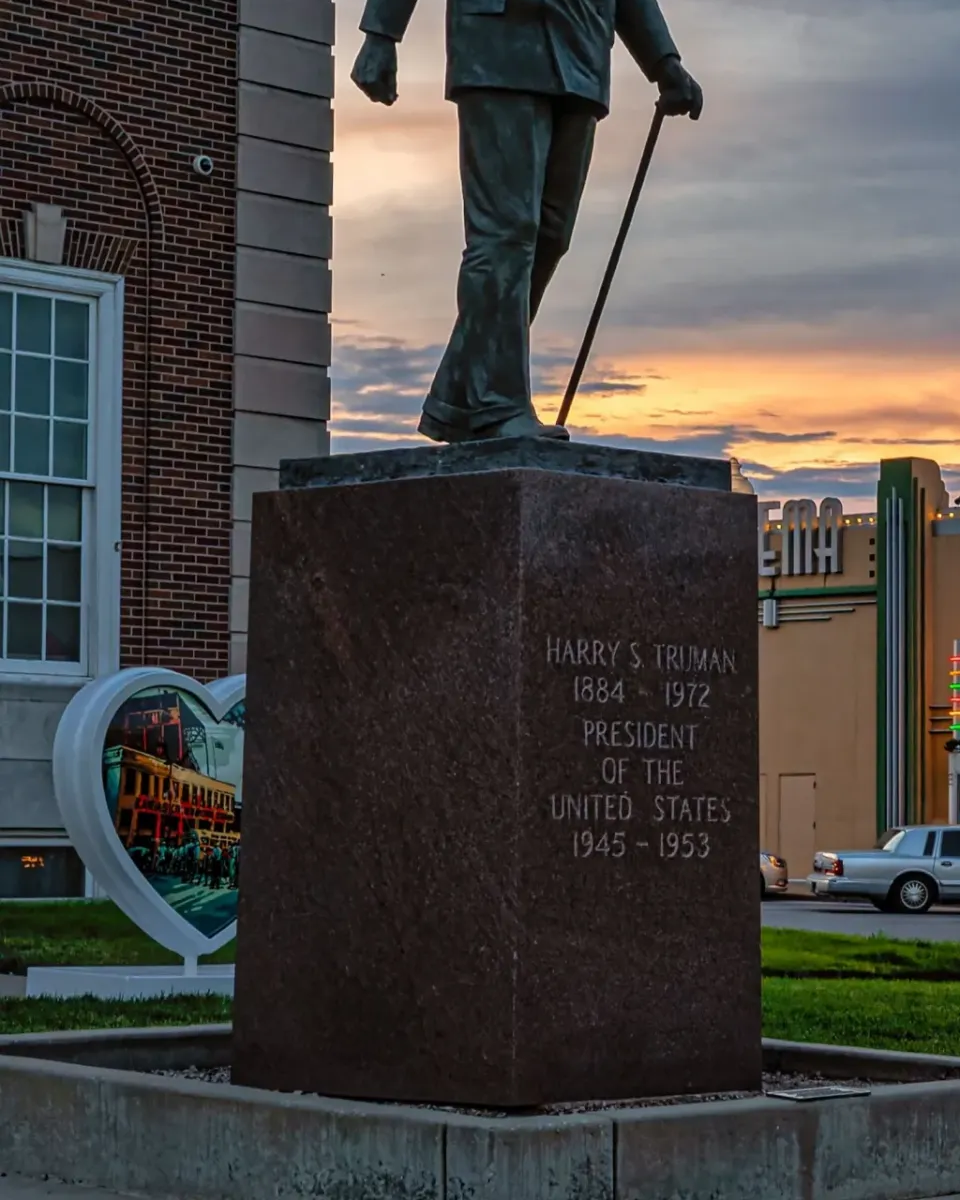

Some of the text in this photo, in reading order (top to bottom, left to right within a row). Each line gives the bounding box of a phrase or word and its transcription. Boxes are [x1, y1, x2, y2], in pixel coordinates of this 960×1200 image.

[546, 635, 620, 668] HARRY
[653, 643, 737, 675] TRUMAN
[574, 675, 625, 703] 1884
[665, 681, 710, 708] 1972
[583, 720, 698, 749] PRESIDENT
[602, 756, 685, 786] OF THE
[550, 793, 732, 823] UNITED STATES
[572, 831, 626, 859] 1945
[659, 831, 710, 859] 1953
